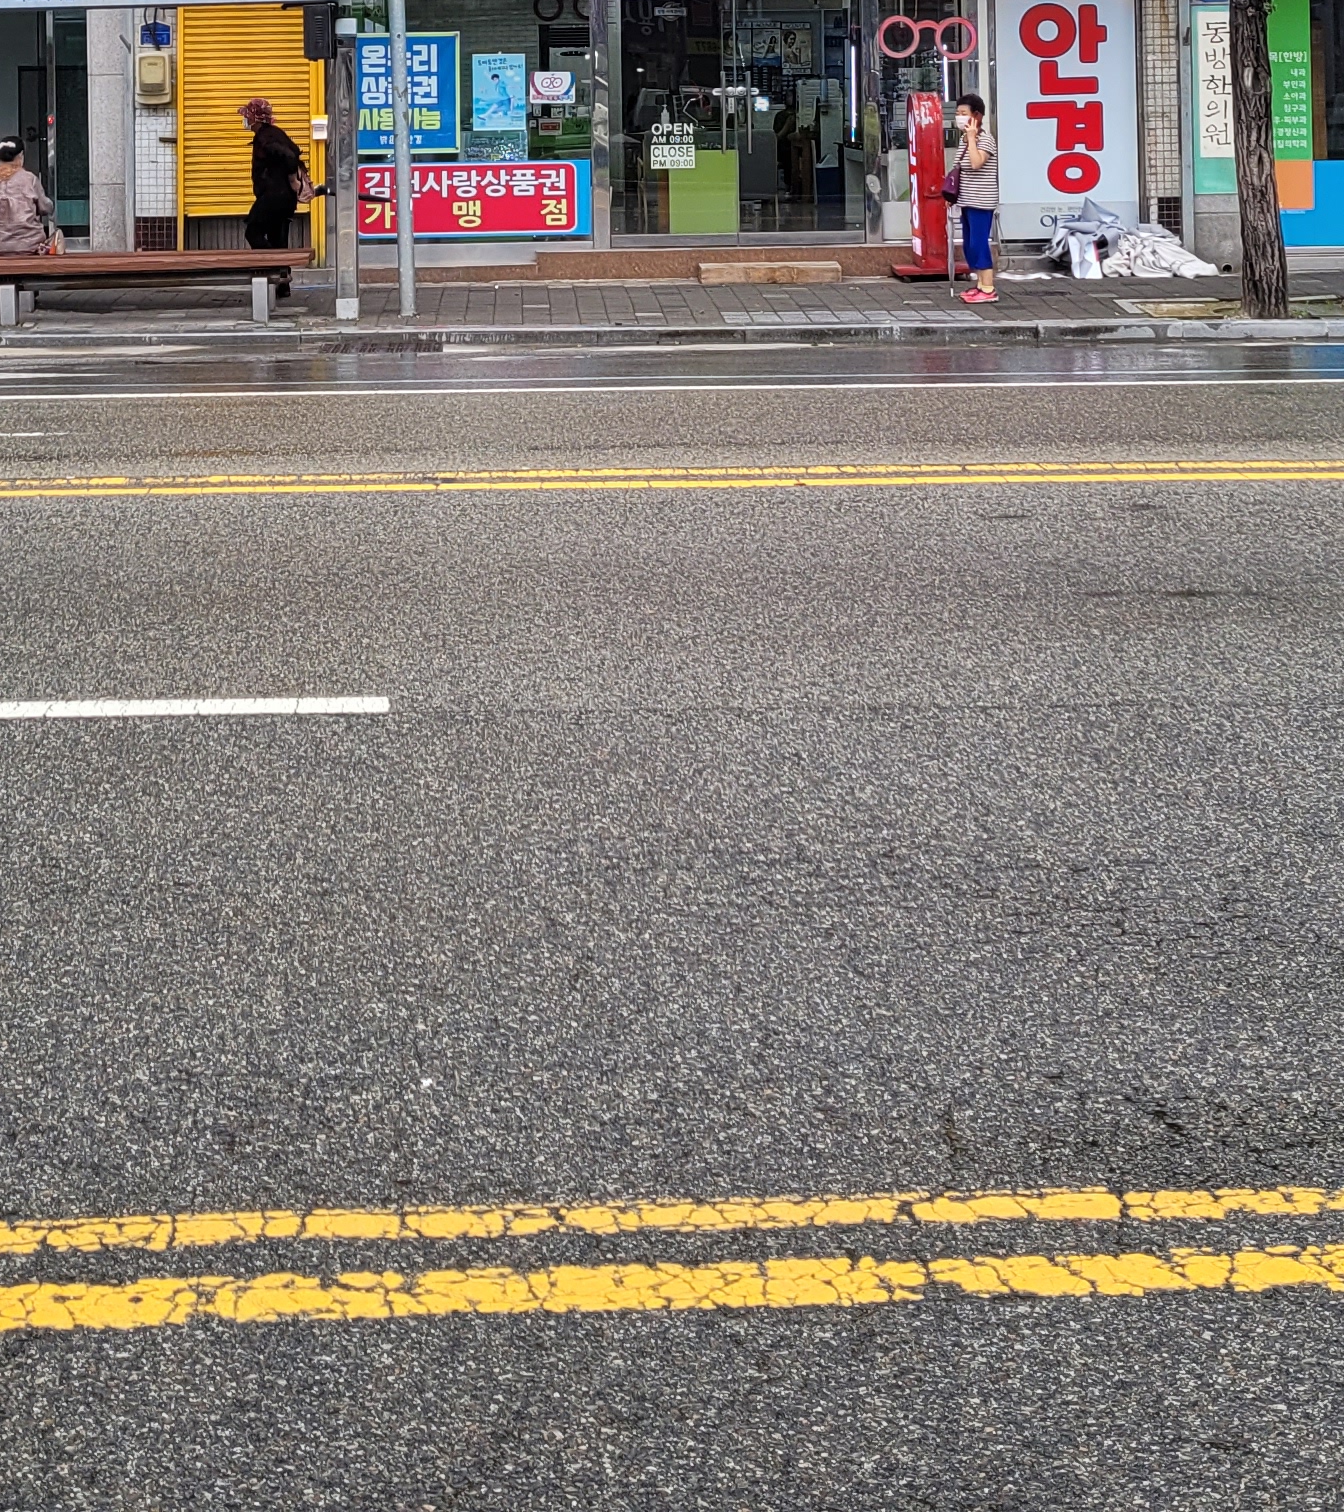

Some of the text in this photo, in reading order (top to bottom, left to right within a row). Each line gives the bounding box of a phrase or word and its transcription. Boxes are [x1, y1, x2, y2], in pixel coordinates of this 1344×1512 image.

[1201, 21, 1232, 146] 동방한의원
[1017, 1, 1108, 195] 안경
[651, 123, 694, 136] OPEN
[651, 136, 694, 144] AM 09:00
[652, 146, 694, 158] CLOSE
[652, 159, 694, 168] PM 09:00
